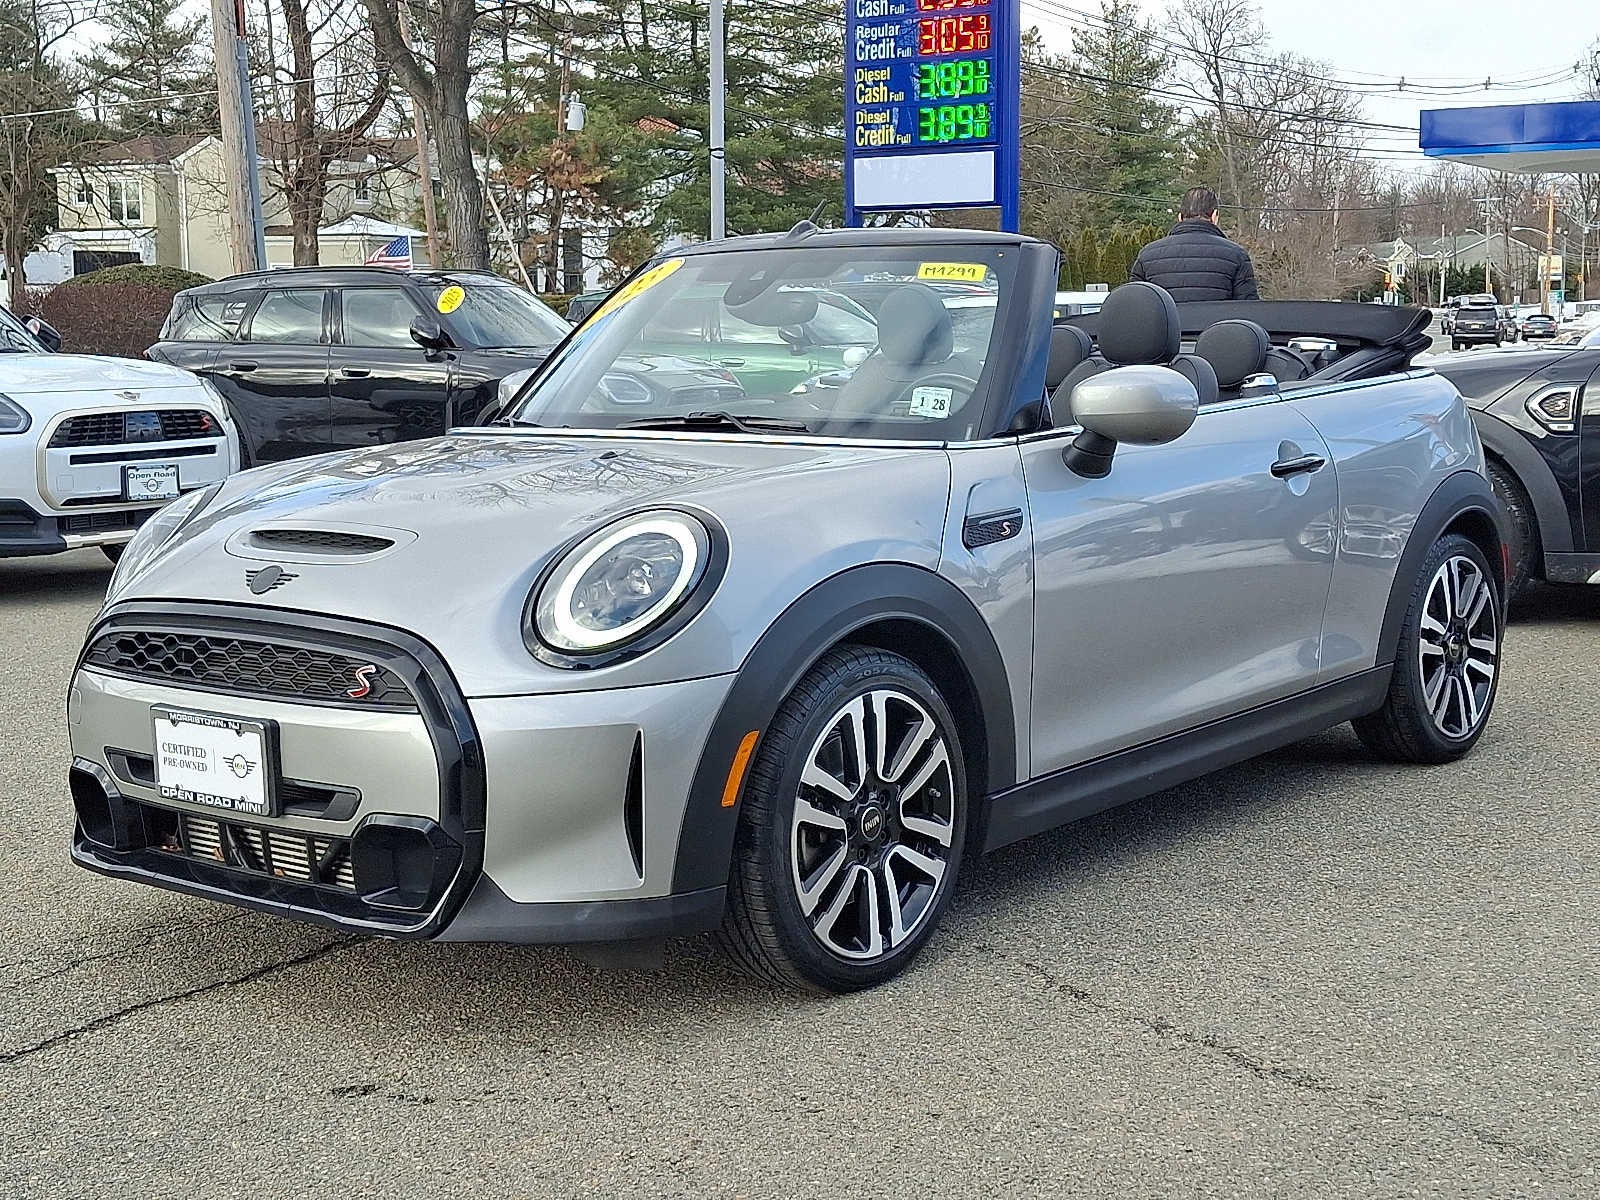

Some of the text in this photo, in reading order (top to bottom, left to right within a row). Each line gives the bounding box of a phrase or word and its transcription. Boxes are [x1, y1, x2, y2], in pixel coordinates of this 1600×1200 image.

[856, 0, 889, 18] Cash
[890, 4, 905, 15] Full
[856, 23, 900, 41] Regular
[856, 38, 912, 61] Credit Full
[856, 66, 891, 83] Diesel
[856, 81, 905, 104] Cash Full
[855, 109, 890, 124] Diesel
[855, 124, 911, 146] Credit Full
[920, 396, 946, 411] 1 28
[128, 472, 151, 481] Open
[1001, 521, 1011, 536] S
[346, 664, 377, 698] S
[228, 721, 240, 730] NJ
[162, 742, 207, 759] CERTIFIED
[163, 756, 208, 772] PRE-OWNED
[161, 786, 261, 814] OPEN ROAD MINI
